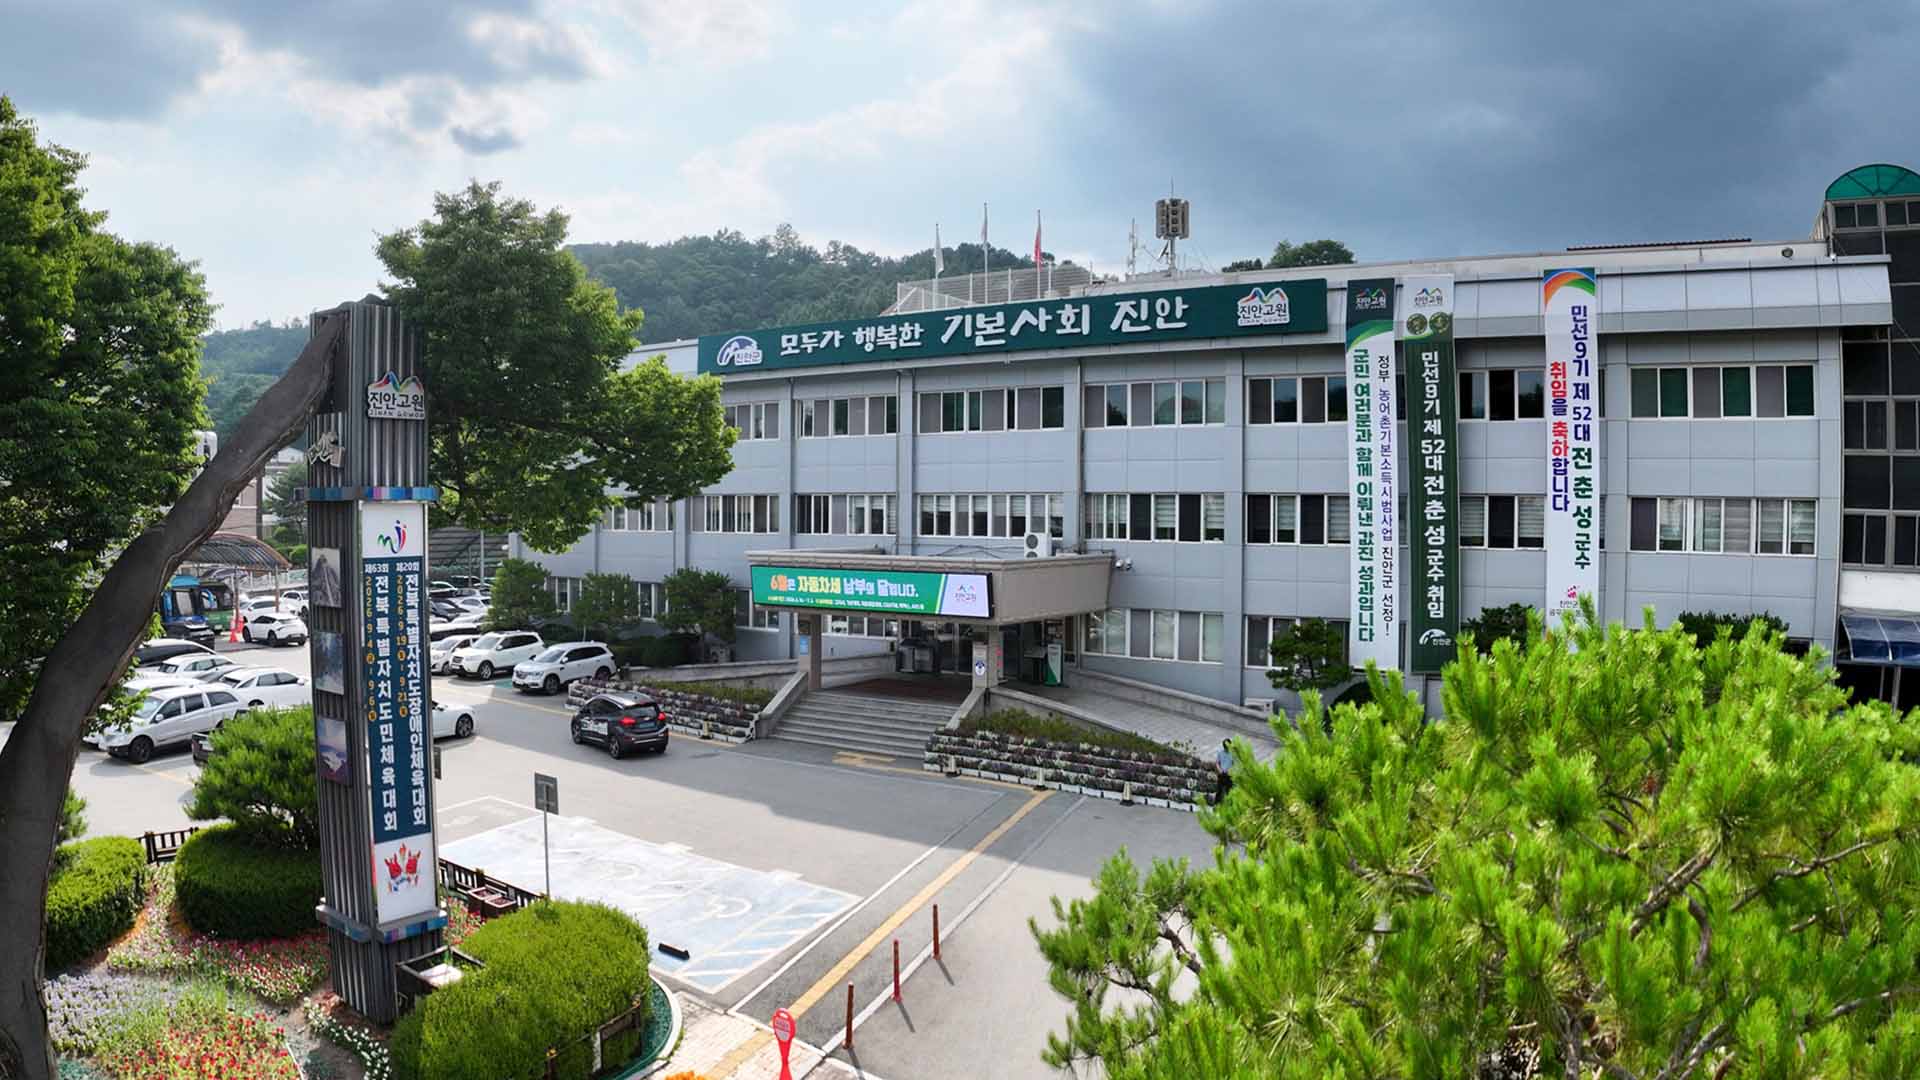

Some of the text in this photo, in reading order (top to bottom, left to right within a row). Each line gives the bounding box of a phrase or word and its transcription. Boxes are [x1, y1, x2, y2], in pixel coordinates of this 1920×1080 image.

[780, 330, 845, 356] 모두가
[852, 322, 925, 353] 행복한
[941, 303, 1091, 346] 기본사회
[1110, 295, 1189, 333] 진안
[1240, 303, 1288, 319] 진안고원
[1570, 304, 1590, 377] 민선9기
[1353, 348, 1370, 379] 군민
[1378, 355, 1391, 383] 정부
[1421, 351, 1442, 416] 민선9기
[370, 391, 424, 412] 진안고원
[1354, 383, 1372, 443] 여러분과
[1550, 361, 1569, 512] 취임을 축하합니다
[1356, 447, 1373, 477] 함께
[1357, 531, 1375, 561] 값진
[1381, 546, 1393, 589] 진안군
[797, 575, 841, 594] 자동차세
[843, 577, 875, 596] 납부의
[1358, 566, 1375, 642] 성과입니다
[1381, 594, 1394, 637] 선정!
